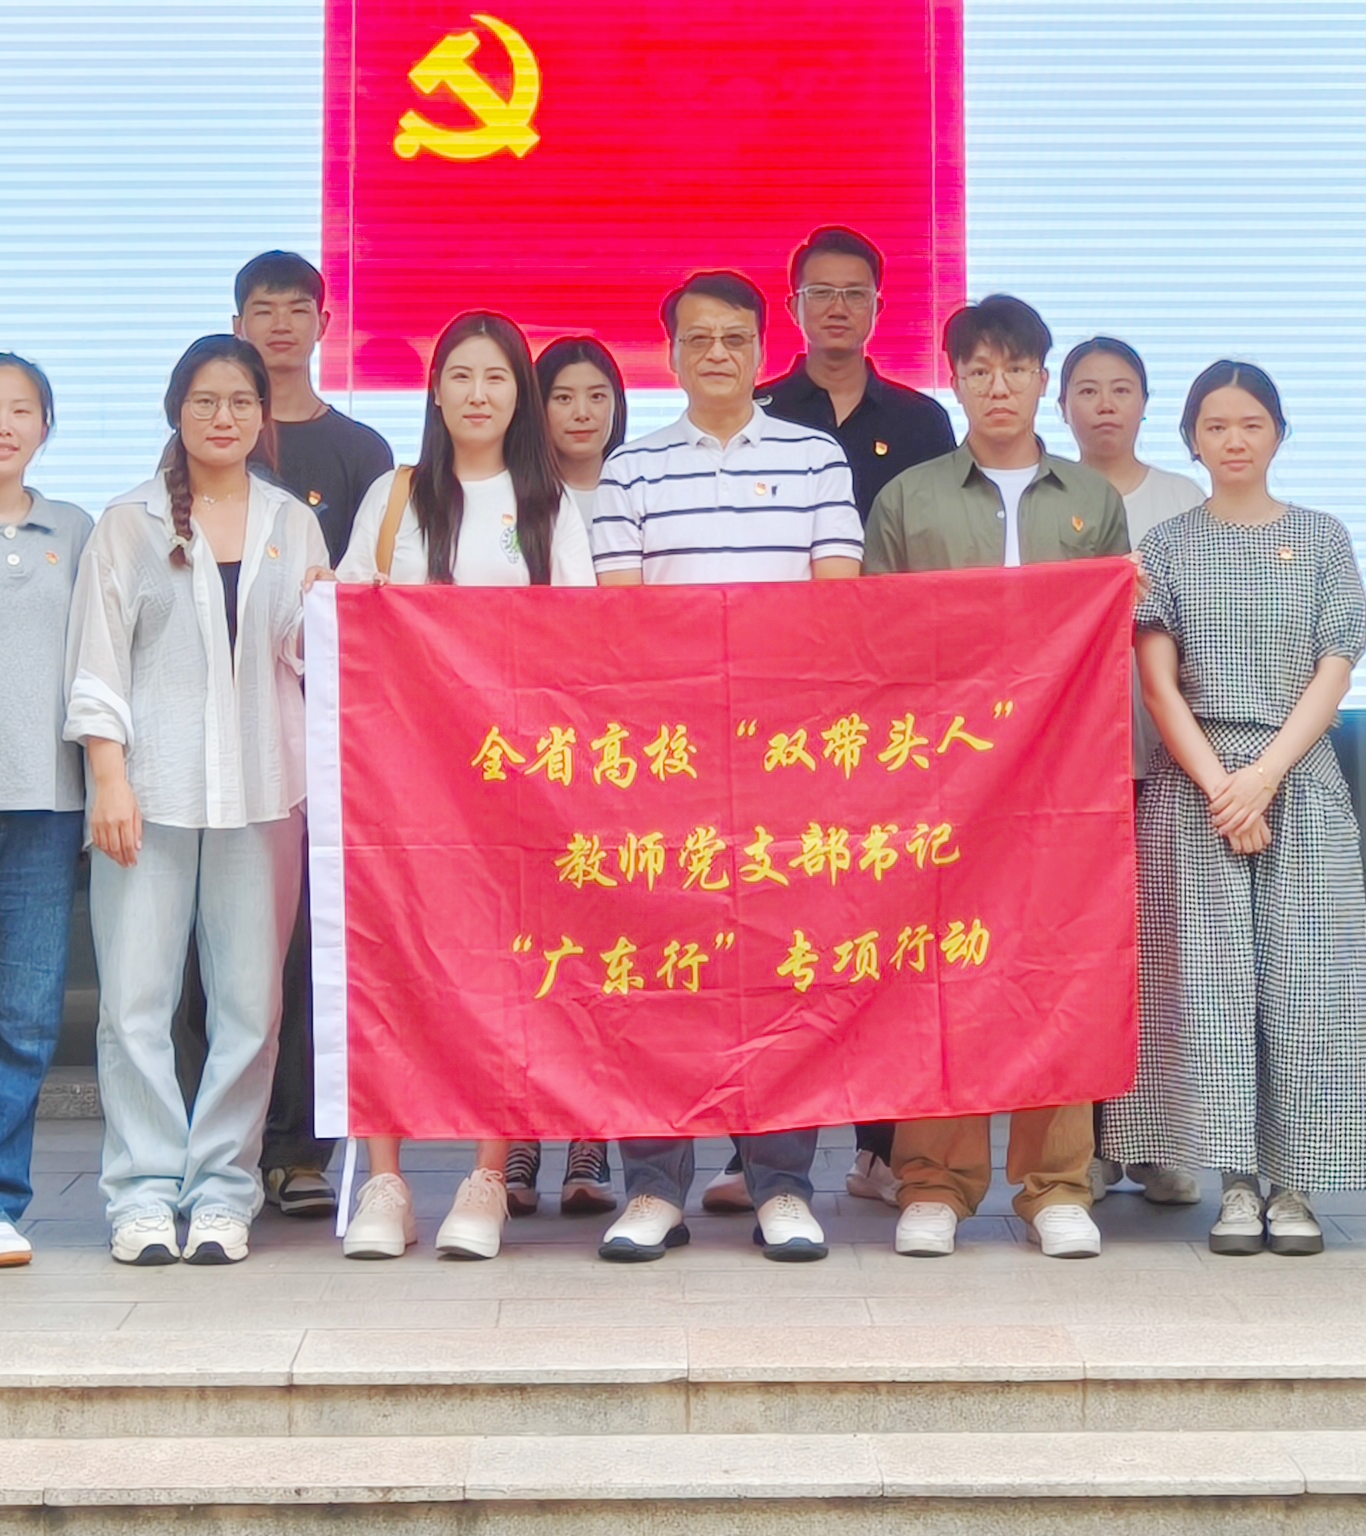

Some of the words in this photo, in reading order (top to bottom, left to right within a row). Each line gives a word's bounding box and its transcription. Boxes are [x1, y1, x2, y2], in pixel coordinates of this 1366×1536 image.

[554, 822, 962, 892] 教师党支部书记
